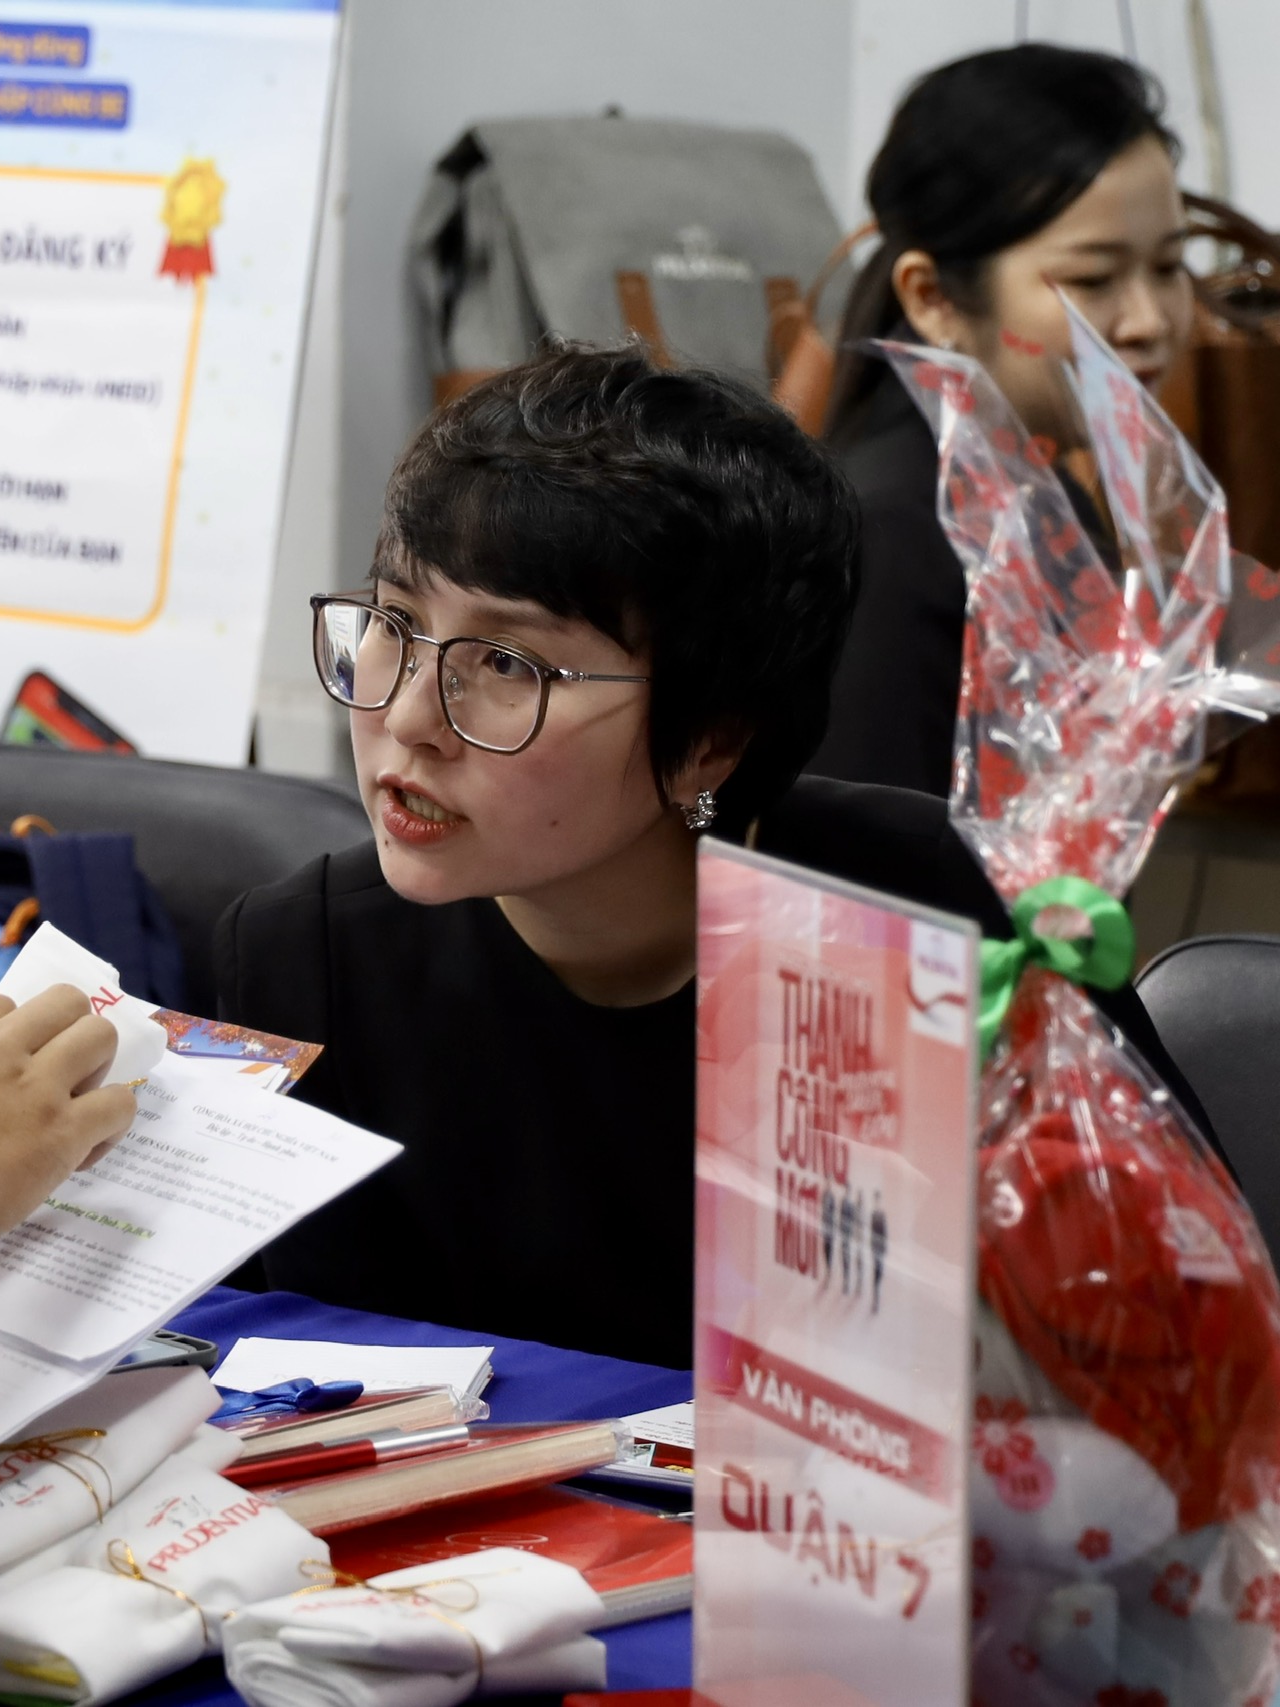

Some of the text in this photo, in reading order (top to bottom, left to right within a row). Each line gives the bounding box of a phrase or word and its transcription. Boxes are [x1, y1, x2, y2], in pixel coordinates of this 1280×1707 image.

[91, 228, 134, 272] KÝ
[808, 1393, 911, 1472] PHÒNG
[146, 1496, 276, 1574] PRUDENTIA
[720, 1460, 932, 1622] QUẬN 7
